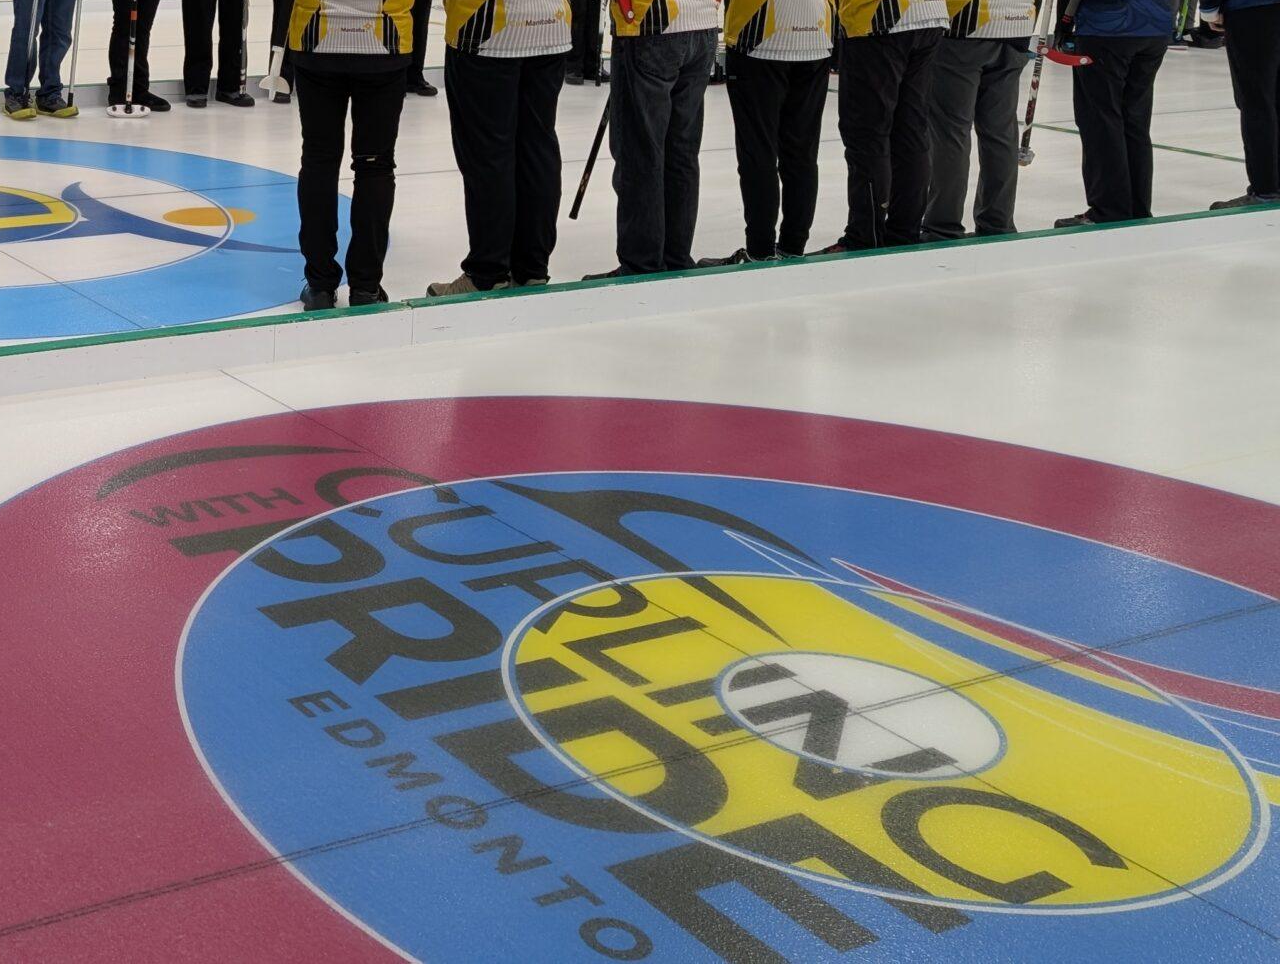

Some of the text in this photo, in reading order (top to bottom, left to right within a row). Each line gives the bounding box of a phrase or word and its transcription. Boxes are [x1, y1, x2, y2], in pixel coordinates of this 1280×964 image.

[129, 486, 304, 529] WITH
[168, 517, 973, 964] PRIDE
[286, 690, 654, 961] EDMONTO
[314, 467, 1129, 906] CURLING
